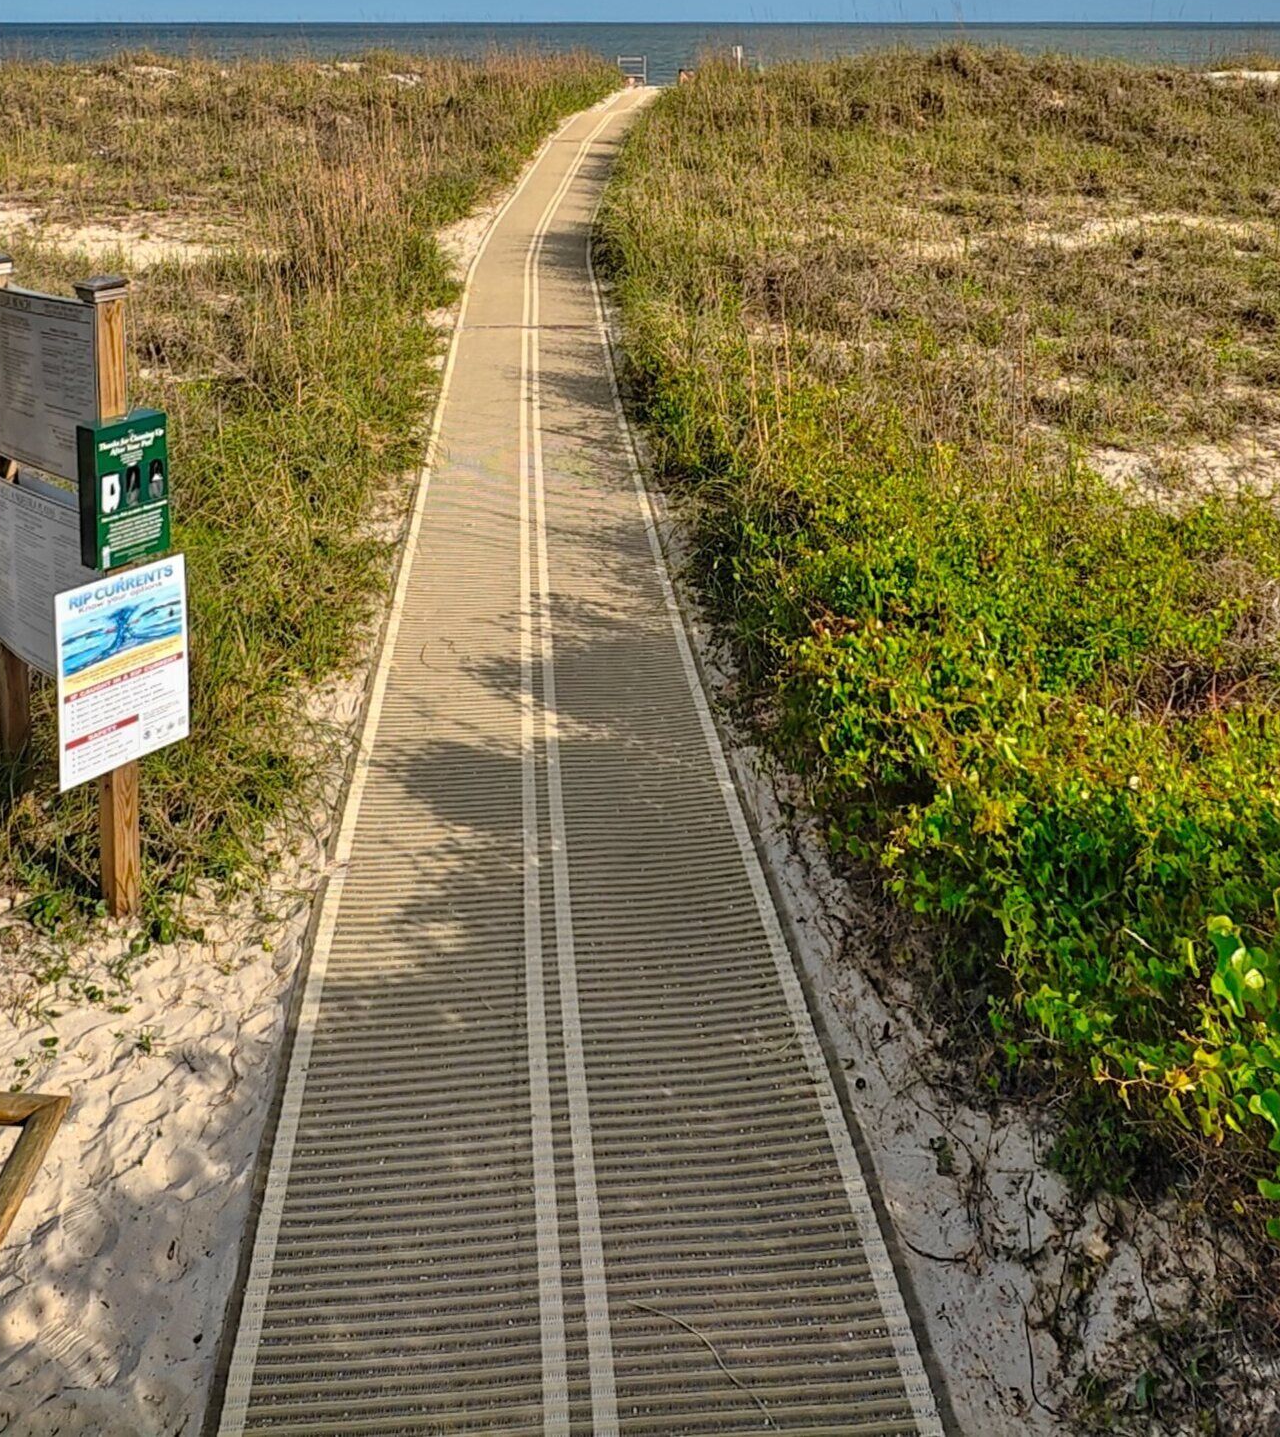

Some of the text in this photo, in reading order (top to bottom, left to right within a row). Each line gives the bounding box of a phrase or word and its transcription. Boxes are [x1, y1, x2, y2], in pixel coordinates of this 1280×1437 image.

[68, 564, 174, 610] RIP CURRENTS
[78, 582, 163, 614] Know your options
[69, 693, 79, 701] IF
[79, 680, 112, 698] CAUGHT
[112, 676, 122, 684] IN
[129, 669, 142, 678] RIP
[143, 655, 178, 673] CURRENT
[87, 724, 118, 741] SAFETY
